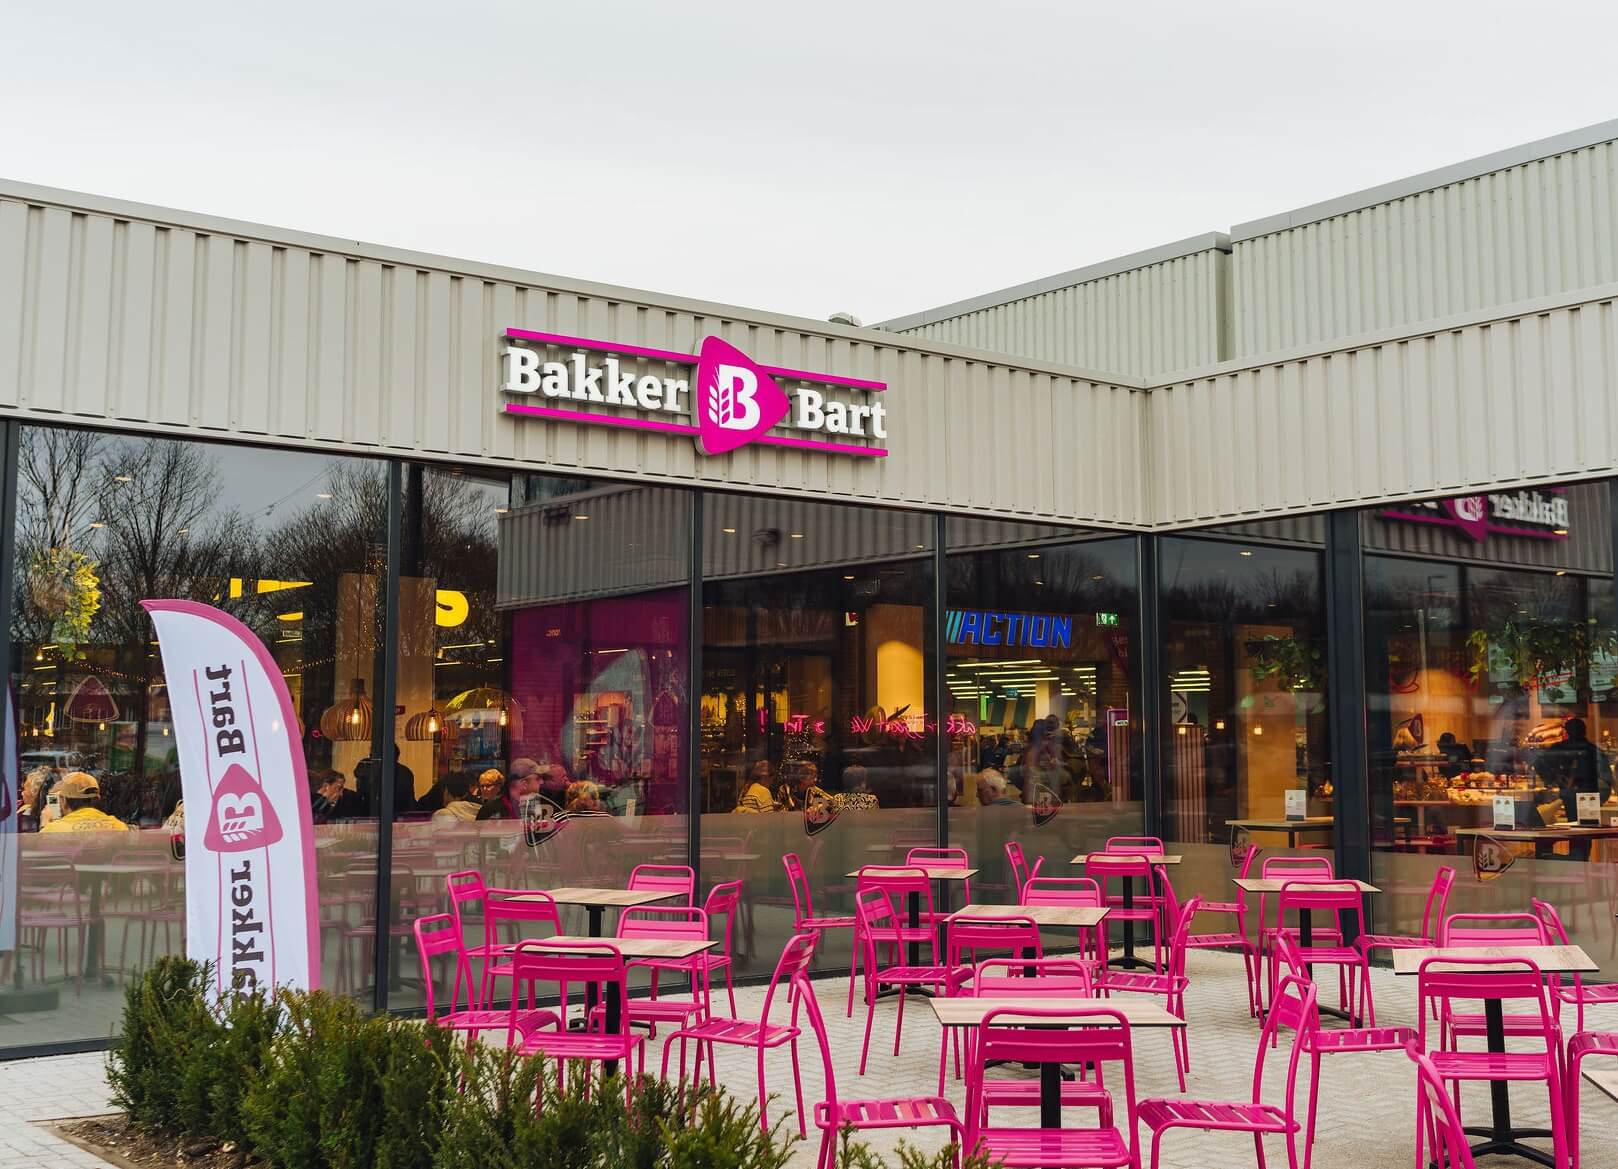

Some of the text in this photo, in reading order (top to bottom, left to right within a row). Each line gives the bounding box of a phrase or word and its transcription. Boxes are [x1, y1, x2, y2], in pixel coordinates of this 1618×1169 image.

[503, 345, 888, 440] Bakker B Bart
[957, 610, 1073, 649] ACTION
